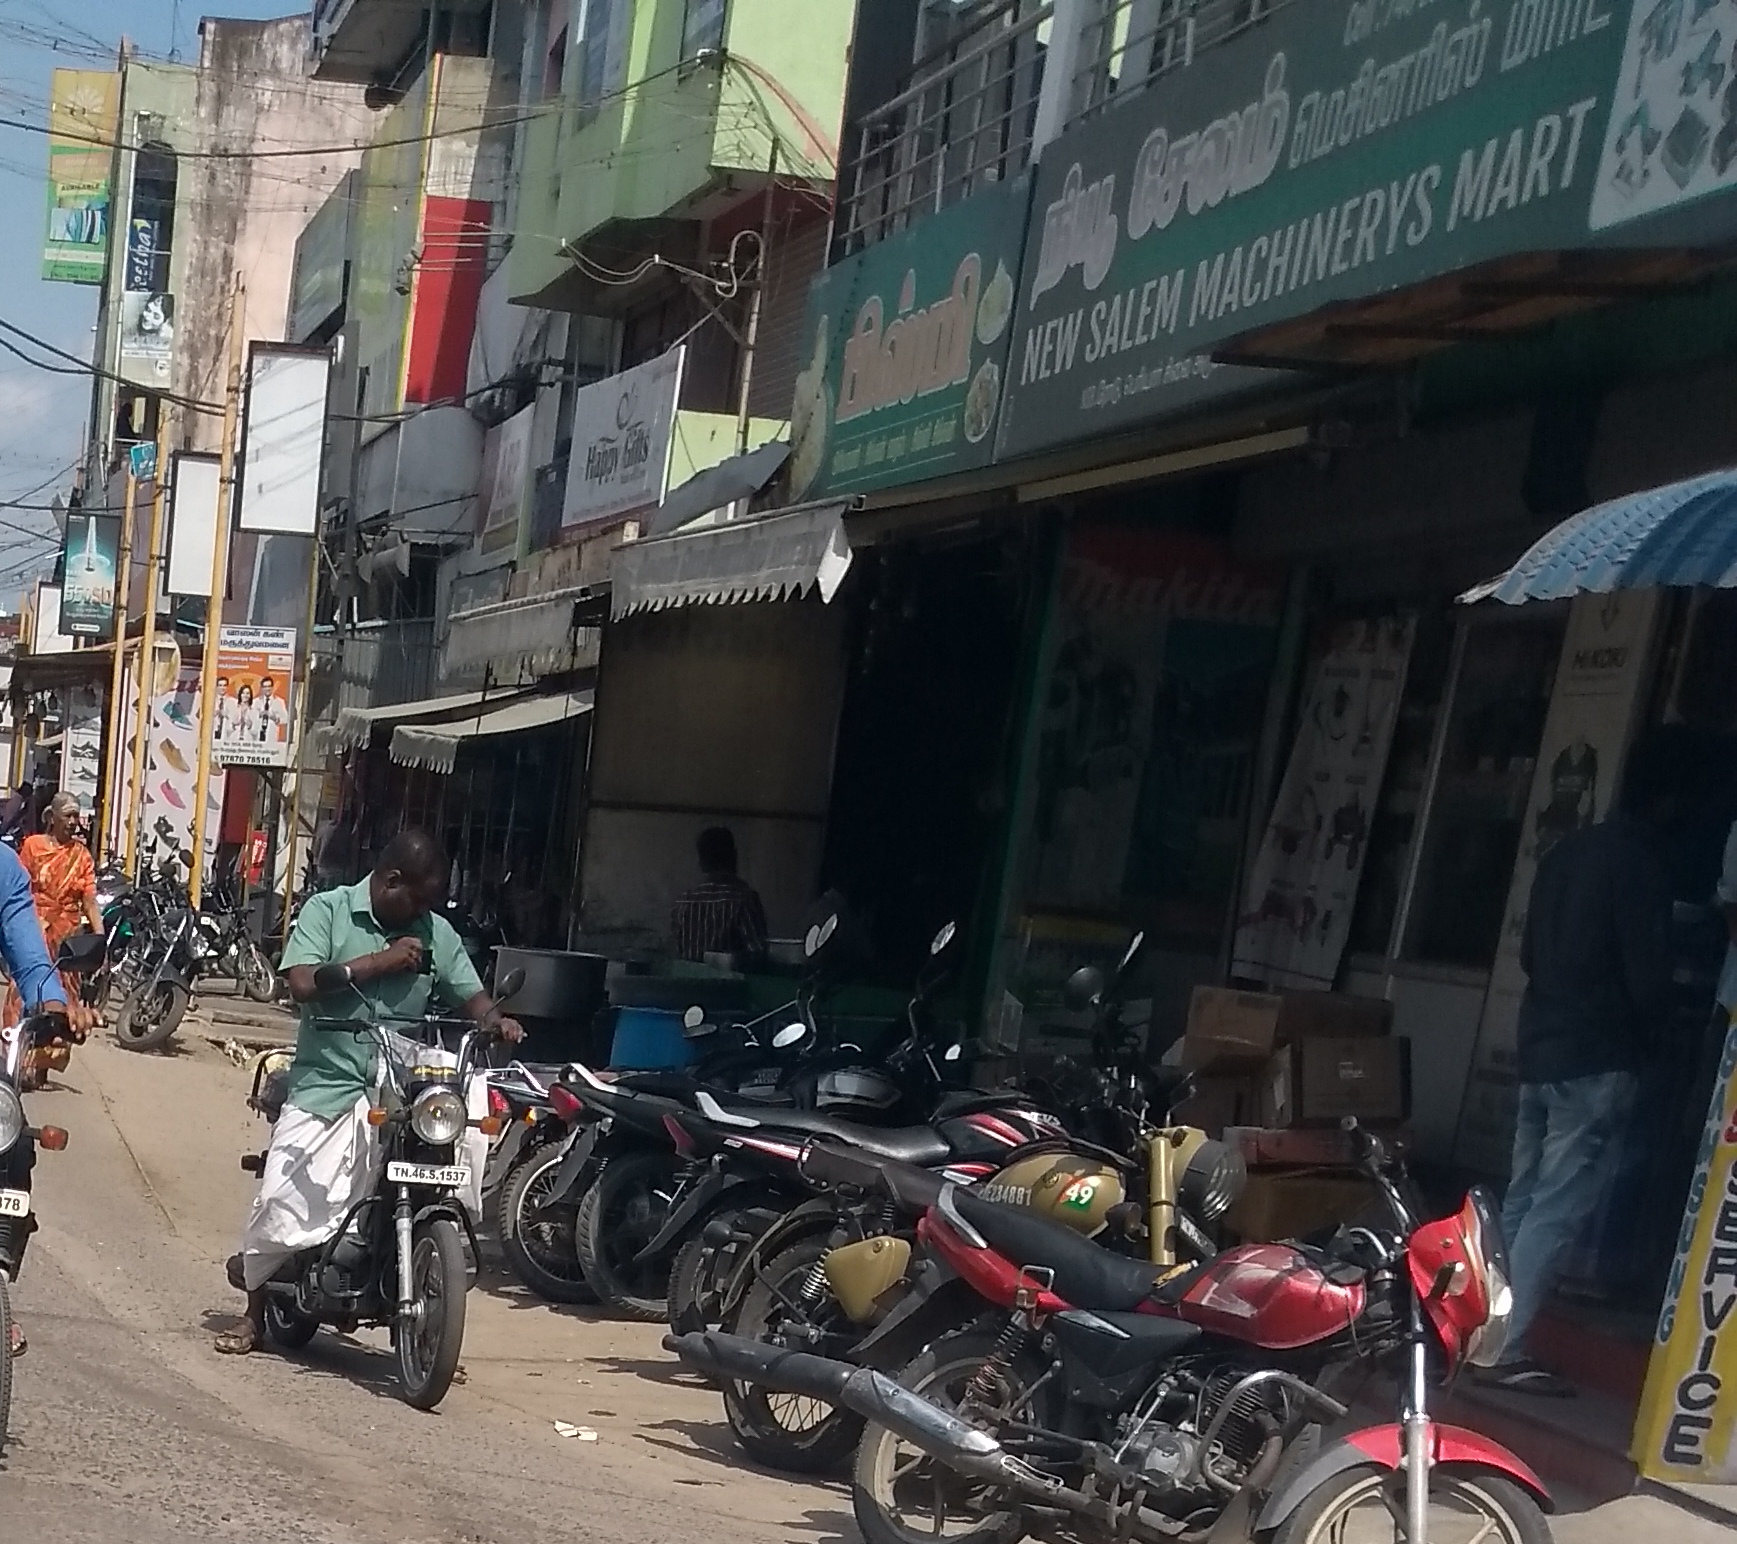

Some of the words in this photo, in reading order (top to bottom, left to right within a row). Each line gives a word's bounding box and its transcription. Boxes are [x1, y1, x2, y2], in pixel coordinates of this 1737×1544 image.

[1031, 162, 1118, 310] நியூ
[1128, 52, 1290, 240] சேலம்
[1020, 309, 1084, 386] NEW
[1084, 267, 1184, 364] SALEM
[1187, 163, 1443, 328] MACHINERYS
[1445, 96, 1597, 232] MART
[129, 229, 151, 291] eetha
[584, 440, 619, 486] Happy
[220, 638, 290, 650] மருத்துவமனை
[226, 629, 261, 637] வாசன்
[262, 629, 285, 639] கண்
[393, 1167, 466, 1182] TN.46.S.1537
[1065, 1182, 1094, 1204] 49
